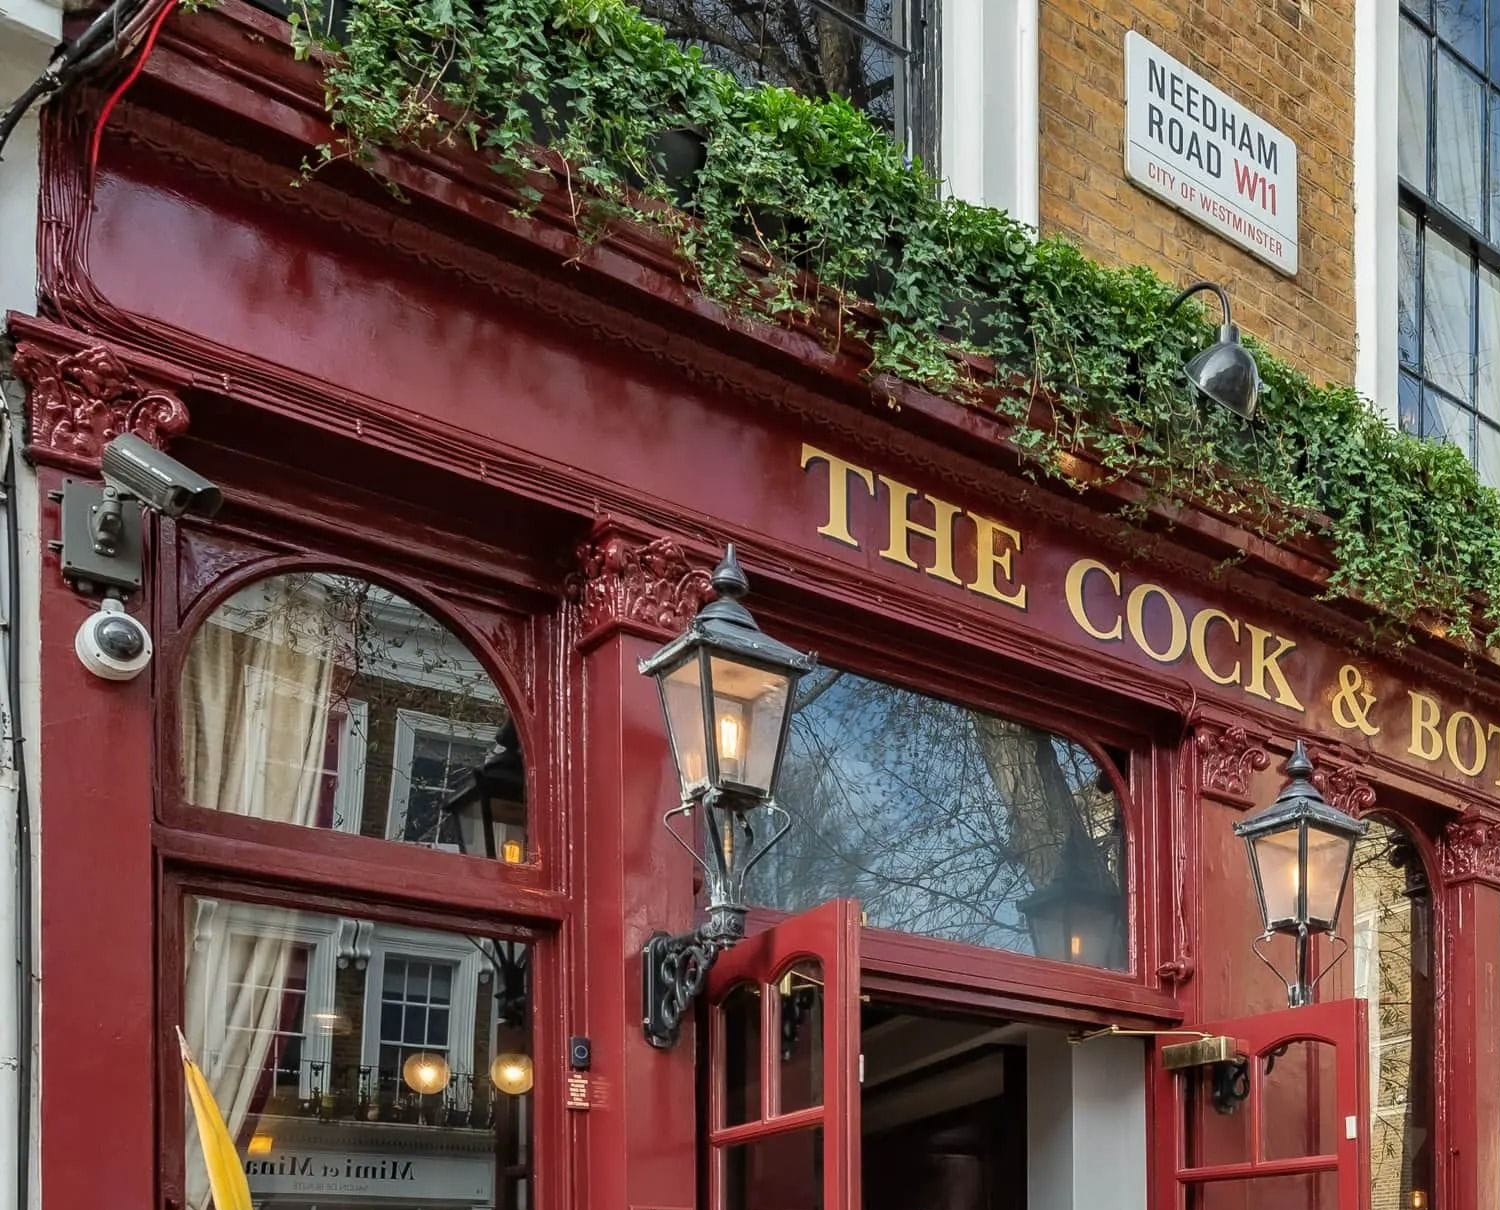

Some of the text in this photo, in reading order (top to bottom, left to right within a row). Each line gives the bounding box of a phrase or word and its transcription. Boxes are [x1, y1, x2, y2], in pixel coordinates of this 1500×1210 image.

[1148, 57, 1279, 176] NEEDHAM
[1148, 102, 1278, 217] ROAD W11
[1148, 161, 1283, 258] CITY OF WESTMINSTER
[800, 442, 1027, 610] THE
[1064, 557, 1306, 712] COCK
[1331, 664, 1380, 737] &
